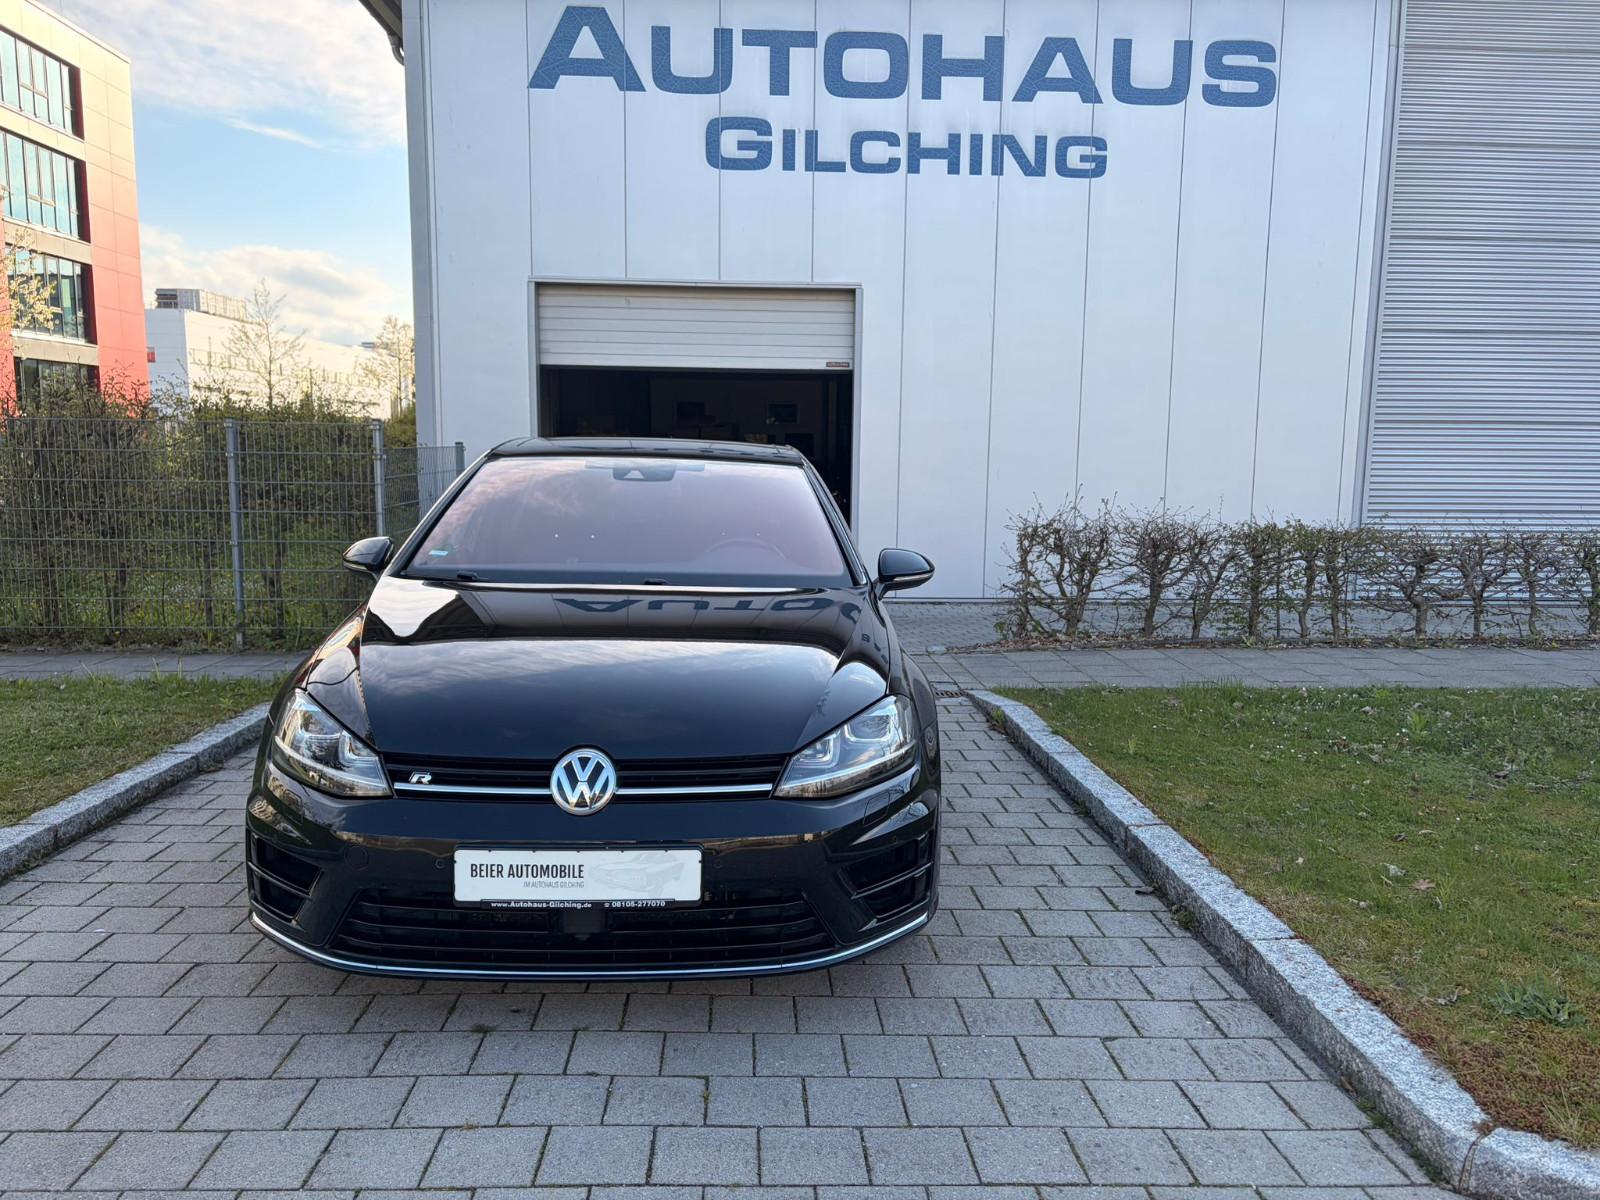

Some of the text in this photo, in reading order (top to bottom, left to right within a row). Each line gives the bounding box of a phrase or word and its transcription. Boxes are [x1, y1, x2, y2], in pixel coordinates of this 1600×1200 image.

[527, 5, 1278, 108] AUTOHAUS
[704, 115, 1109, 179] GILCHING
[409, 771, 432, 784] R
[553, 751, 614, 812] VW
[470, 863, 585, 879] BEIER AUTOMOBILE
[523, 880, 585, 889] IM AUTOHAUS GILCHING
[490, 900, 592, 909] www.Autohaus-Gilching.de
